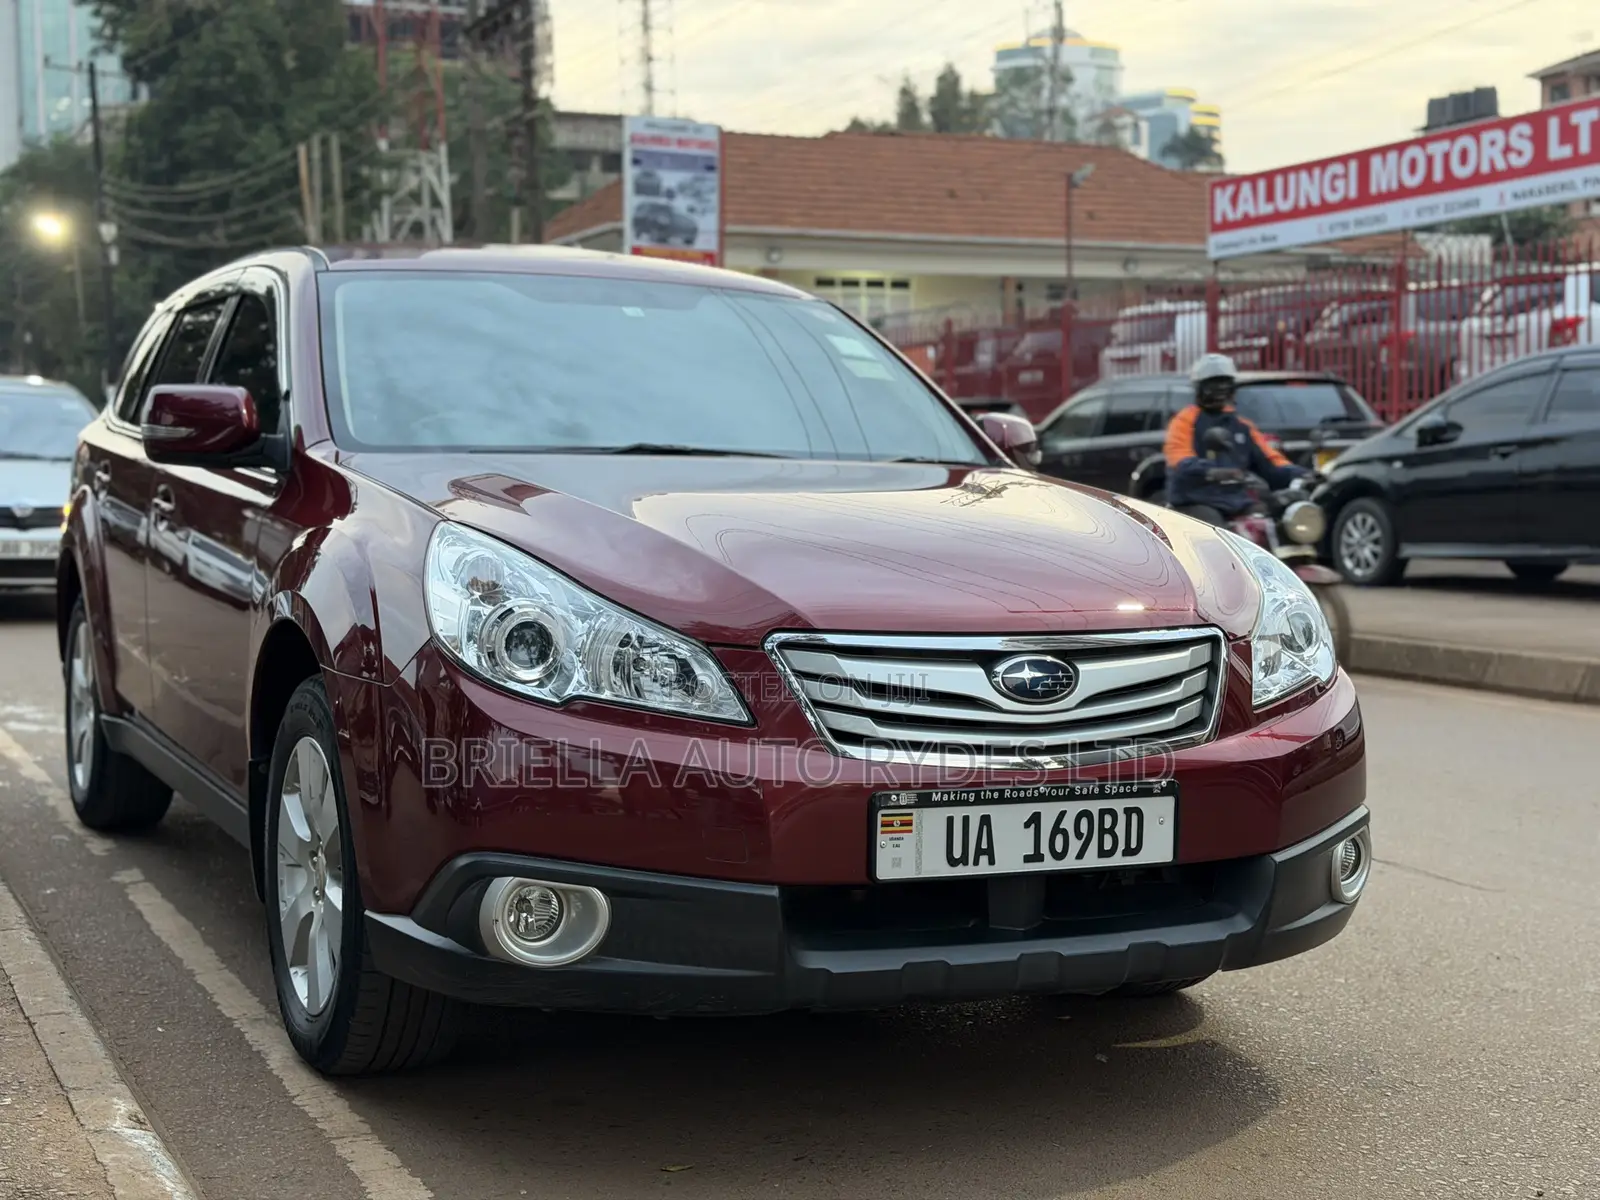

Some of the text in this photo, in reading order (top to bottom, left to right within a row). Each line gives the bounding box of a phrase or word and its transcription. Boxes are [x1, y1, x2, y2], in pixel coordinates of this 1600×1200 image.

[1212, 106, 1599, 224] KALUNGI MOTORS LT
[931, 790, 976, 803] Making
[980, 790, 999, 800] the
[1004, 787, 1039, 799] Roads
[1044, 786, 1070, 797] Your
[1074, 784, 1100, 796] Safe
[1104, 783, 1138, 796] Space
[945, 806, 1145, 868] UA 169BD
